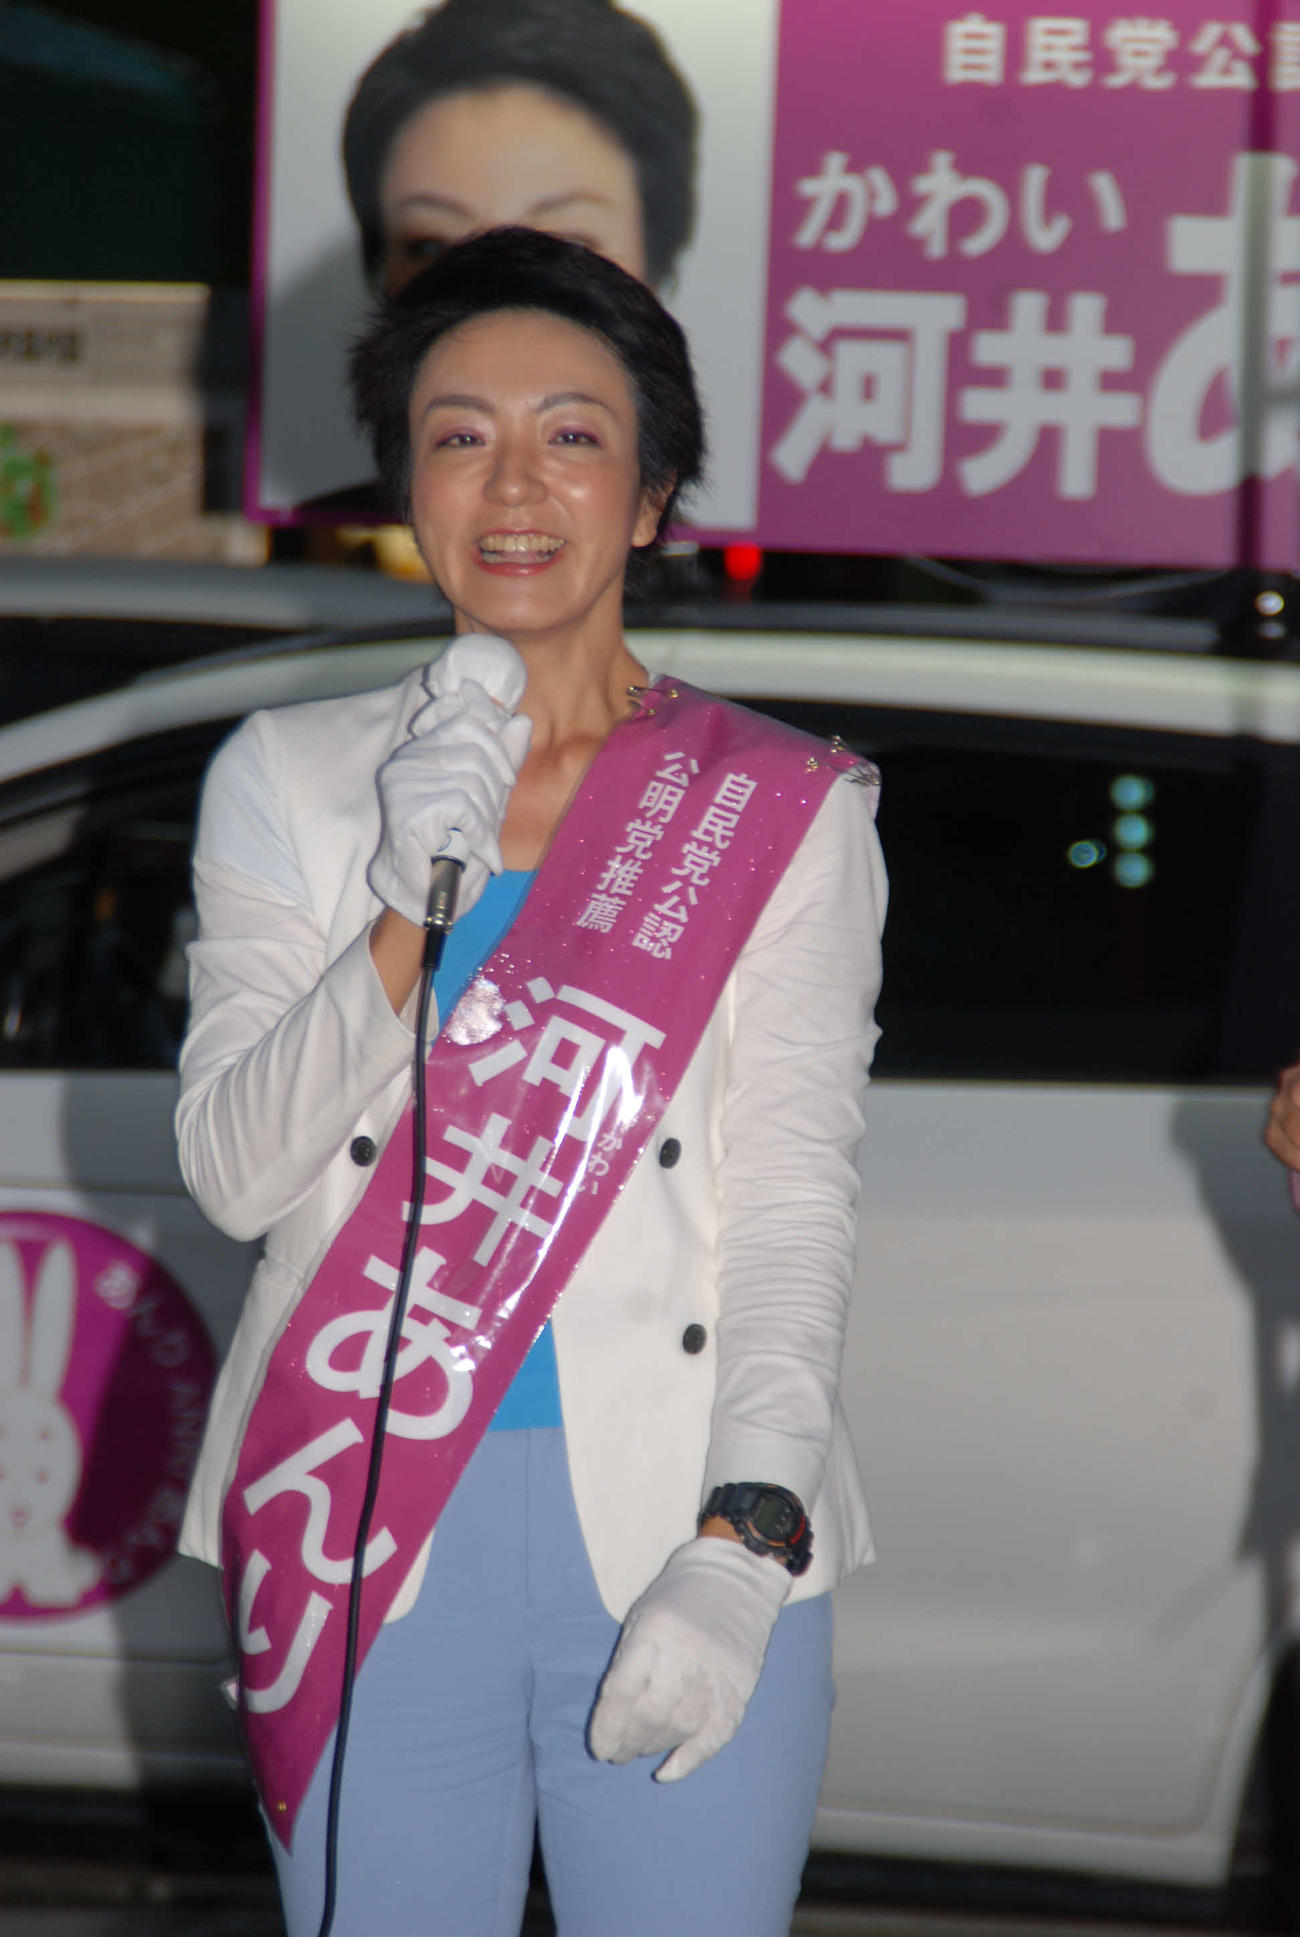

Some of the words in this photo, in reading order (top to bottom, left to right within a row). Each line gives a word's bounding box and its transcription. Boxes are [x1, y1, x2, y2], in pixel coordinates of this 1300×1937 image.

[793, 150, 1127, 259] かわい
[576, 751, 700, 933] 公明党推薦
[632, 772, 757, 960] 自民党公認
[222, 977, 667, 1714] 河井あんり
